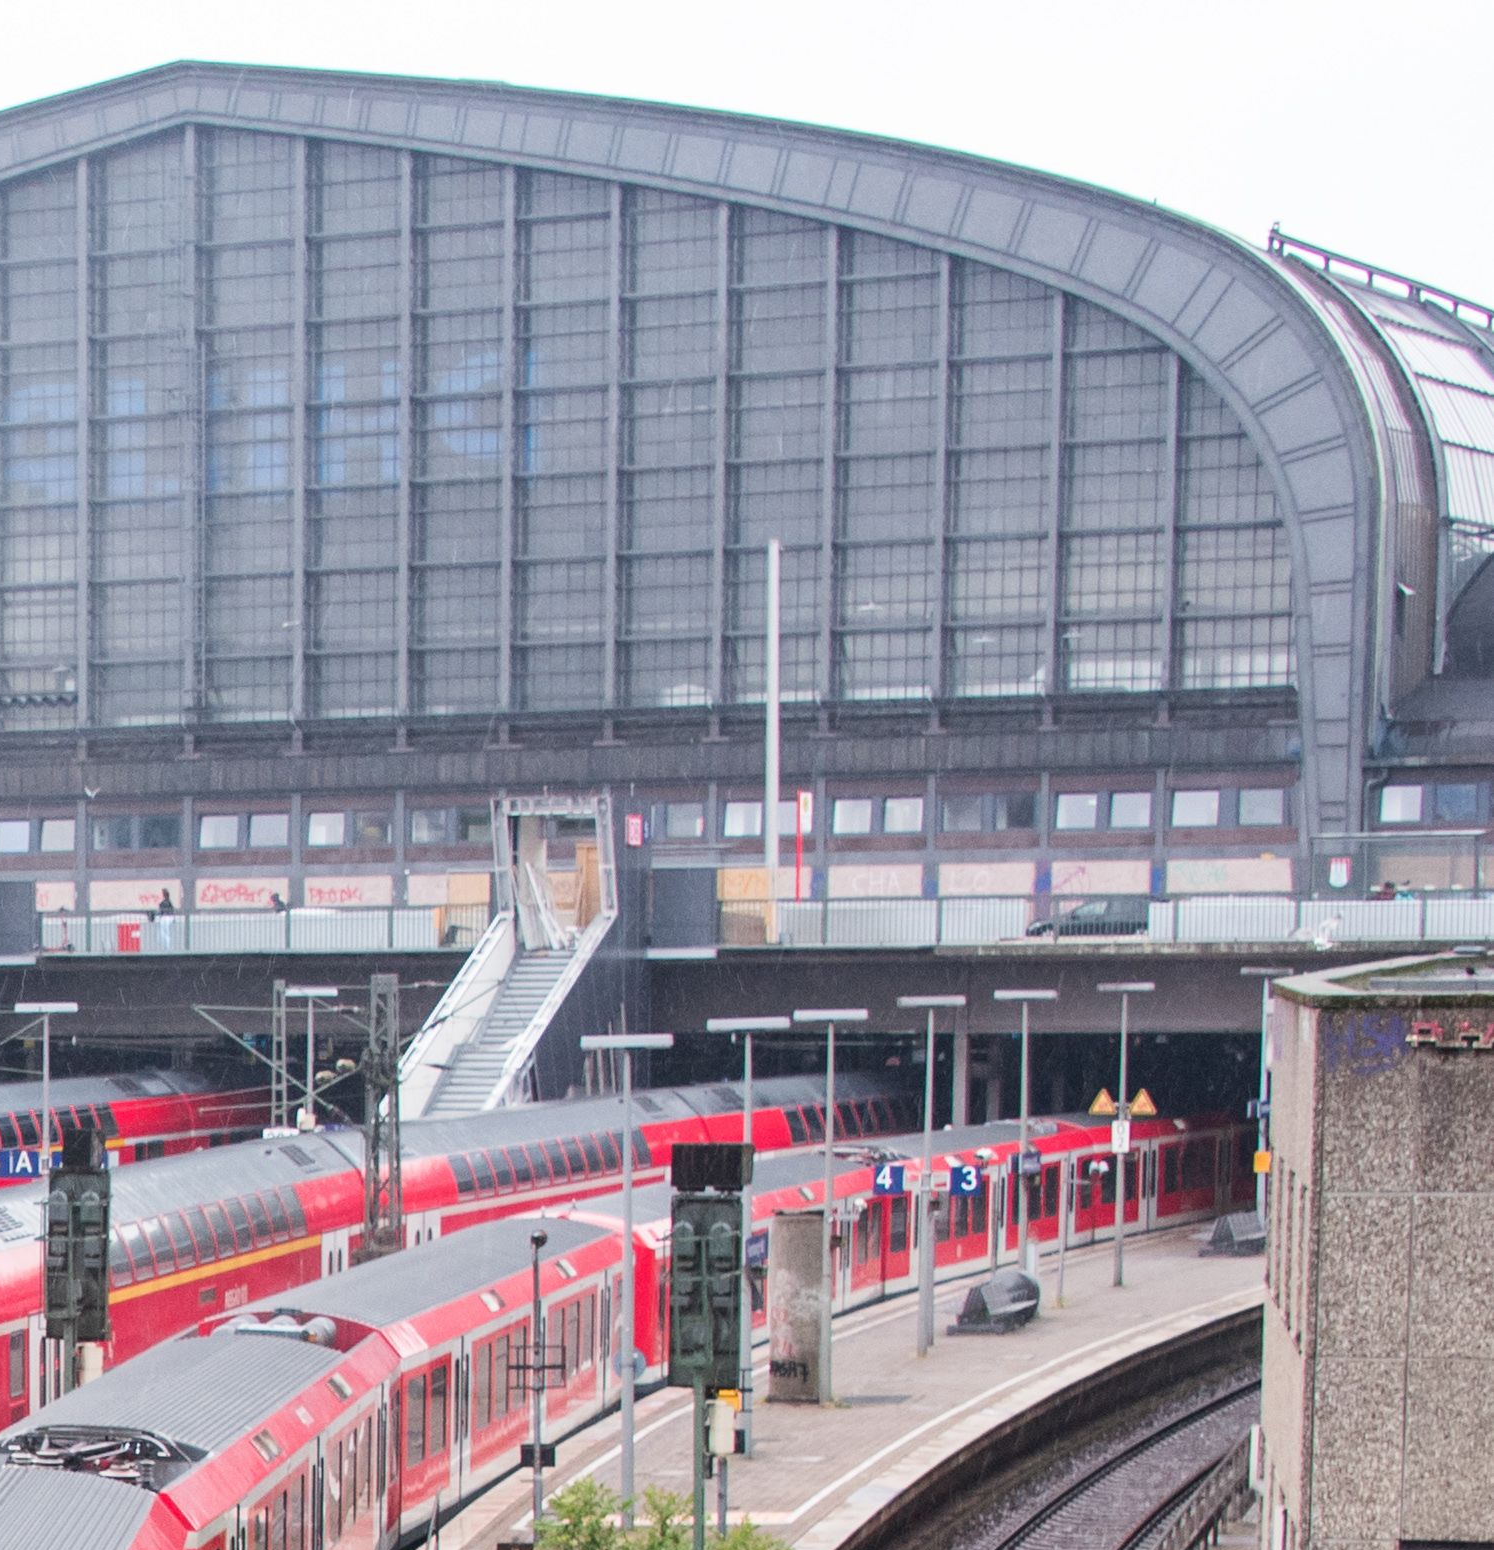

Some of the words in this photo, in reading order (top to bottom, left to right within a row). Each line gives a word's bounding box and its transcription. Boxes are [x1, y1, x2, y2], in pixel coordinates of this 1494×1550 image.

[15, 1150, 33, 1173] A
[876, 1165, 892, 1190] 4
[960, 1165, 977, 1191] 3
